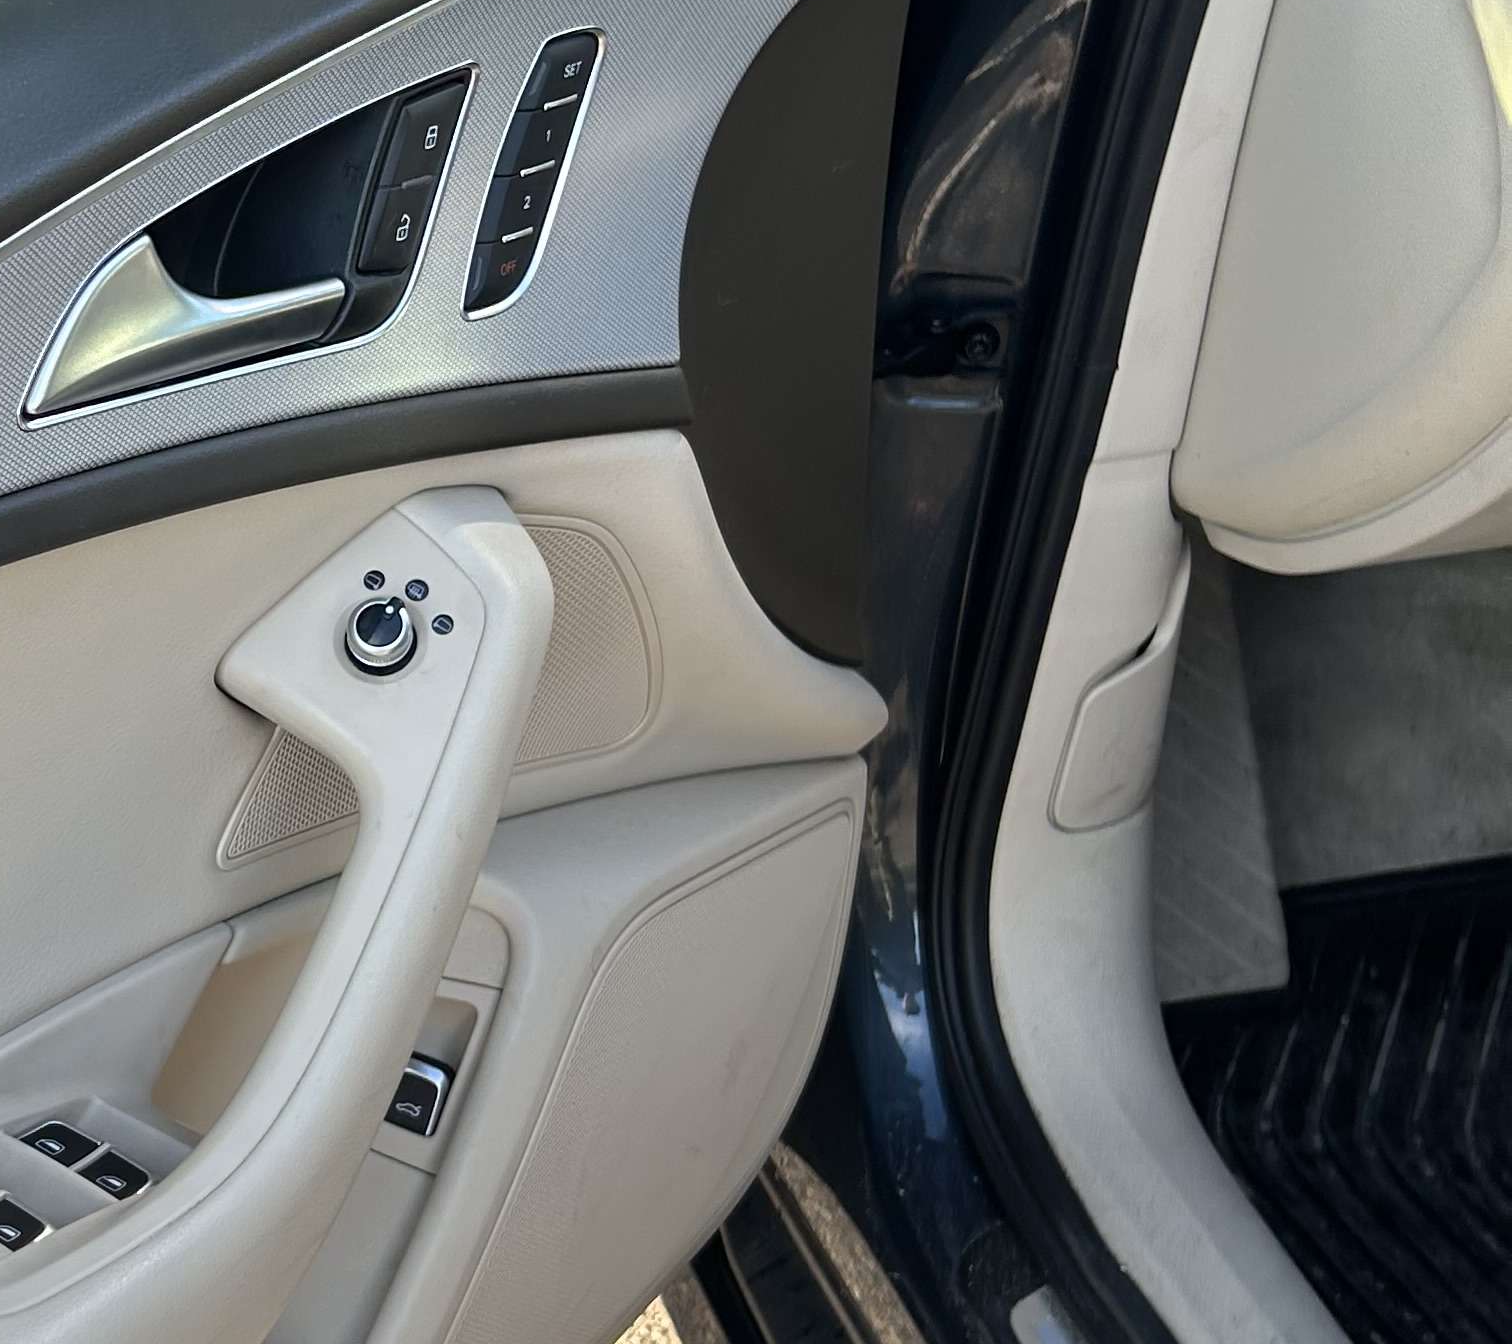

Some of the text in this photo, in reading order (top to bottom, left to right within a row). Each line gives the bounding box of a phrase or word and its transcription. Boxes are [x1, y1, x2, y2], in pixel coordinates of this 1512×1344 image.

[563, 60, 583, 78] SET
[545, 129, 551, 142] 1
[522, 195, 531, 210] 2
[500, 259, 518, 277] OFF
